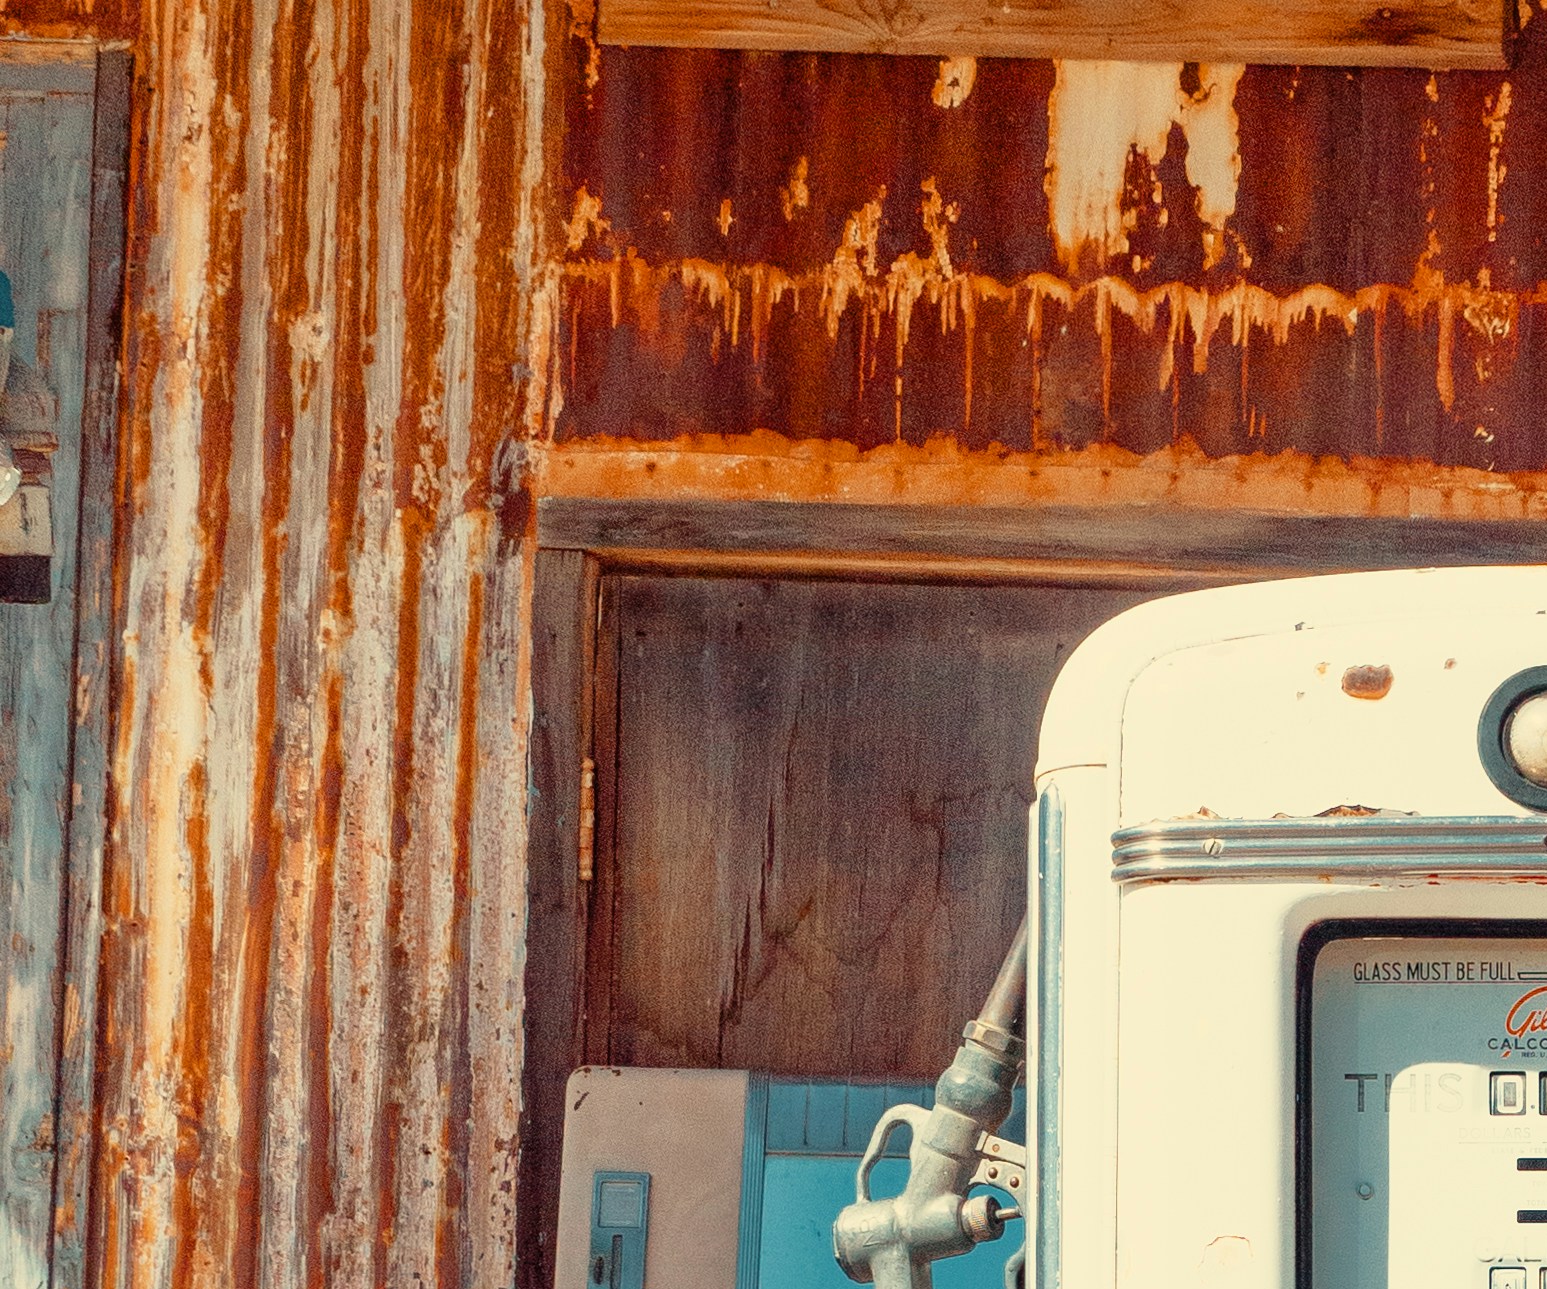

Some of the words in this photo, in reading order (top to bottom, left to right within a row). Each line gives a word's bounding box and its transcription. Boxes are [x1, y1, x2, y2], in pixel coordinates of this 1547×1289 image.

[1354, 962, 1401, 981] GLASS
[1407, 962, 1451, 981] MUST
[1457, 962, 1475, 980] BE
[1480, 962, 1515, 980] FULL
[1344, 1072, 1464, 1113] THIS
[1458, 1127, 1532, 1139] DOLLARS
